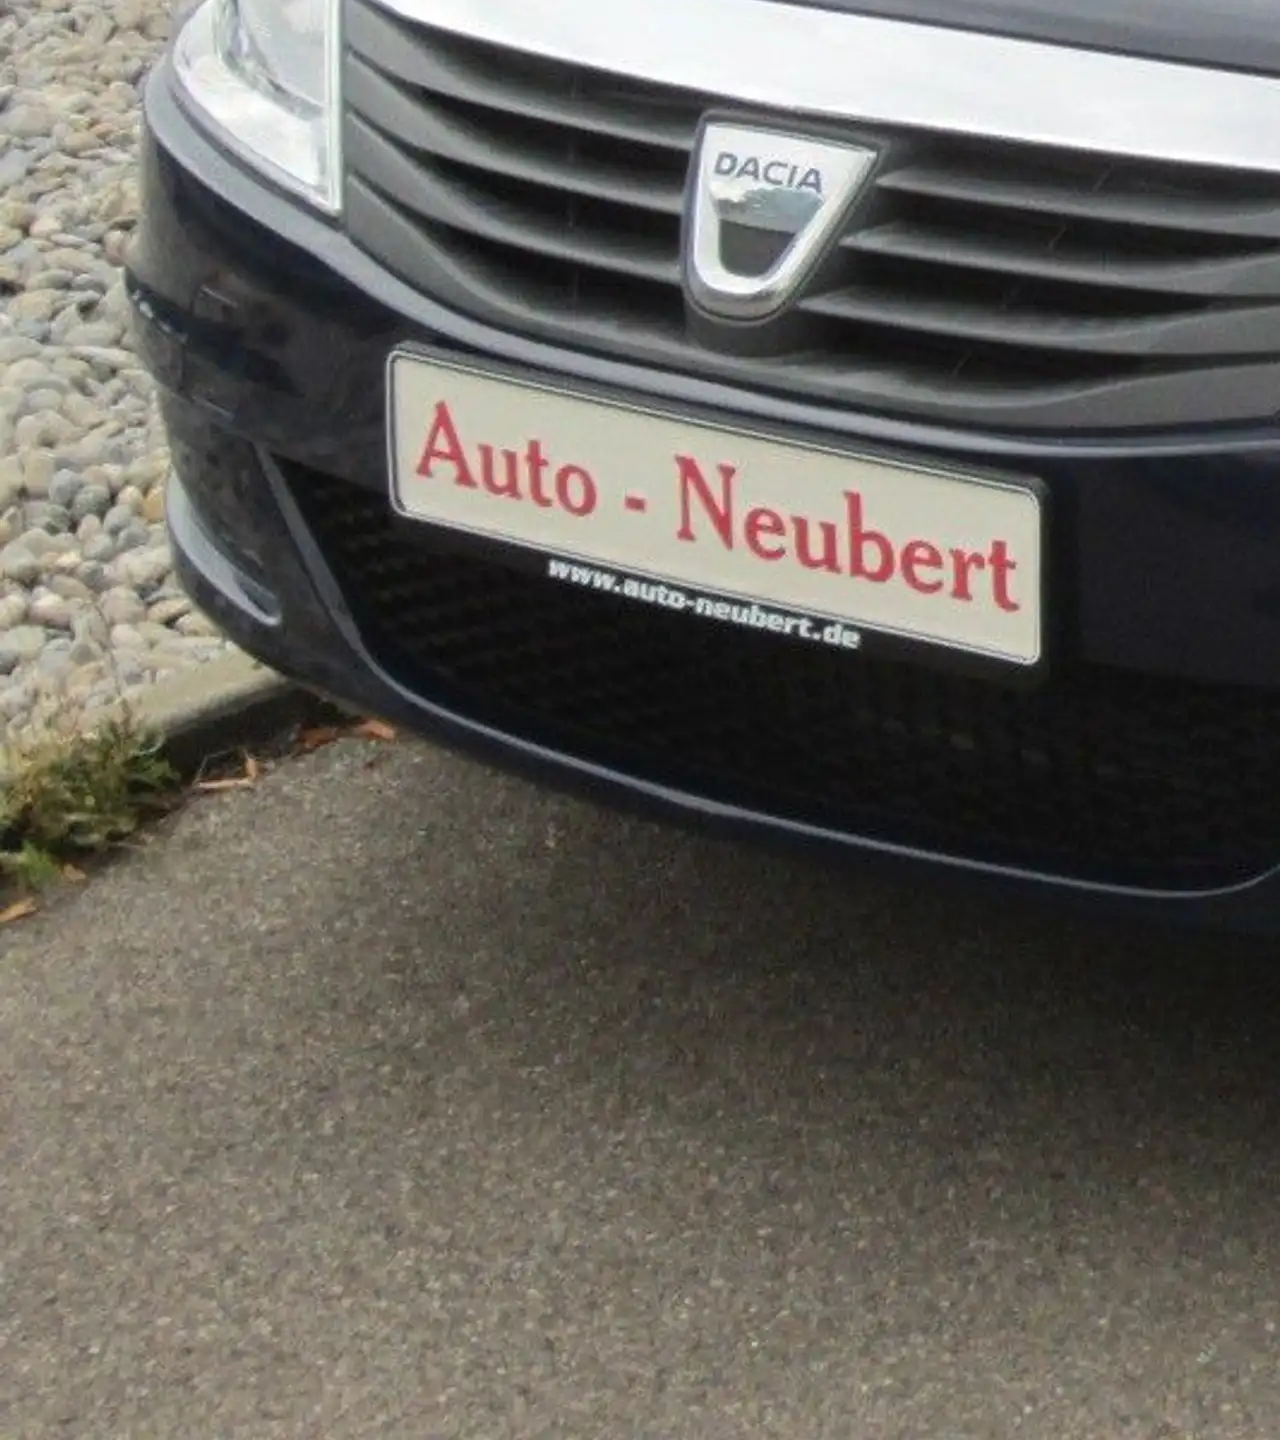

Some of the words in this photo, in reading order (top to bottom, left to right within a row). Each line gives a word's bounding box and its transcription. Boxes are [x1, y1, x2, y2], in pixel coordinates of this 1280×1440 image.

[714, 152, 822, 193] DACIA
[416, 401, 597, 517] Auto
[674, 455, 1020, 613] Neubert
[548, 559, 861, 649] www.auto-neubert.de
